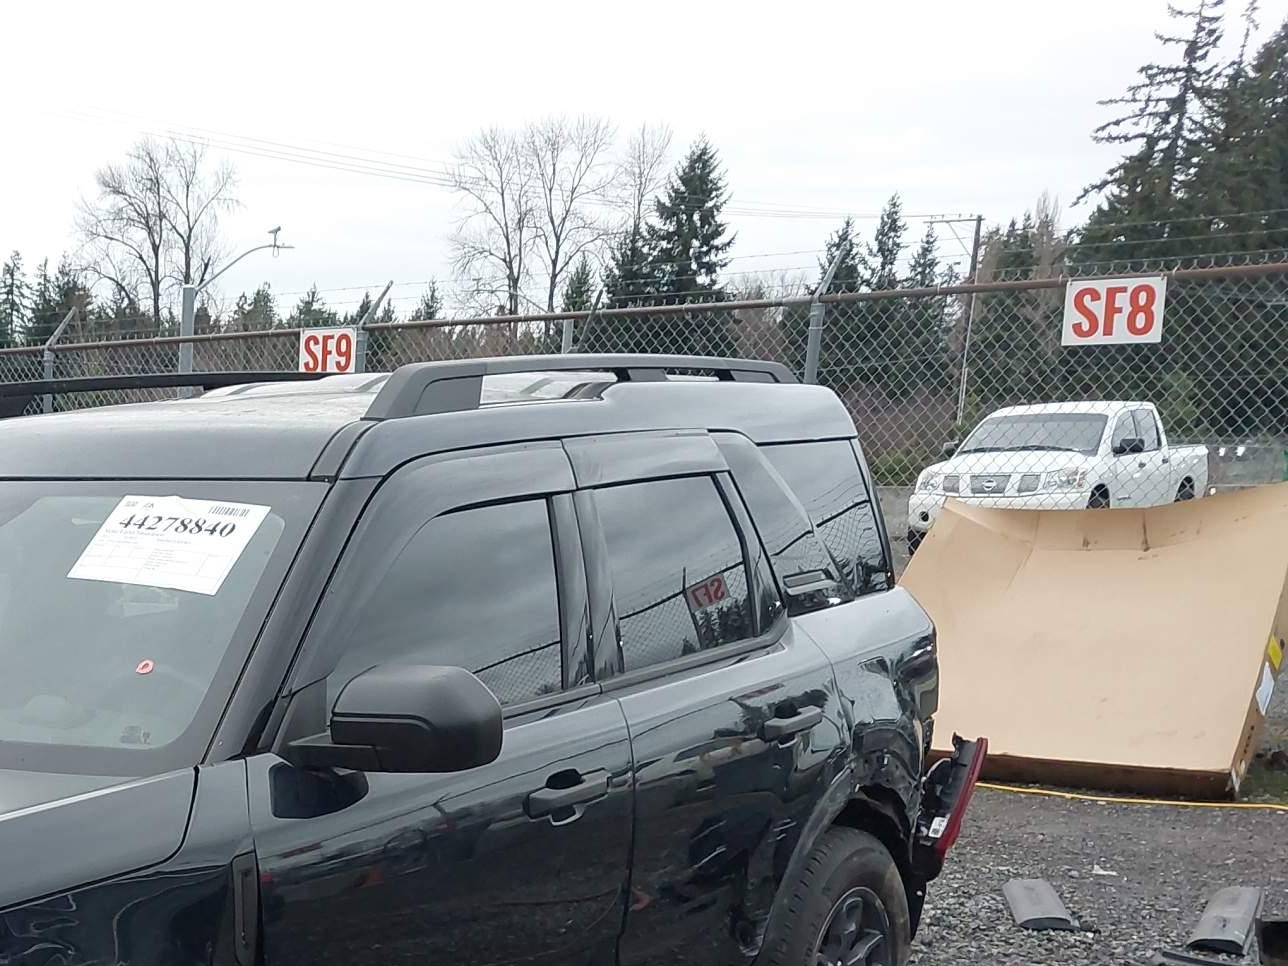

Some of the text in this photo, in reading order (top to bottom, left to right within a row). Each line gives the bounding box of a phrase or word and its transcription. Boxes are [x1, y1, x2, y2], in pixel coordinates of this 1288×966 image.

[1072, 283, 1157, 338] SF8
[303, 333, 352, 372] SF9
[119, 513, 237, 538] 44278840
